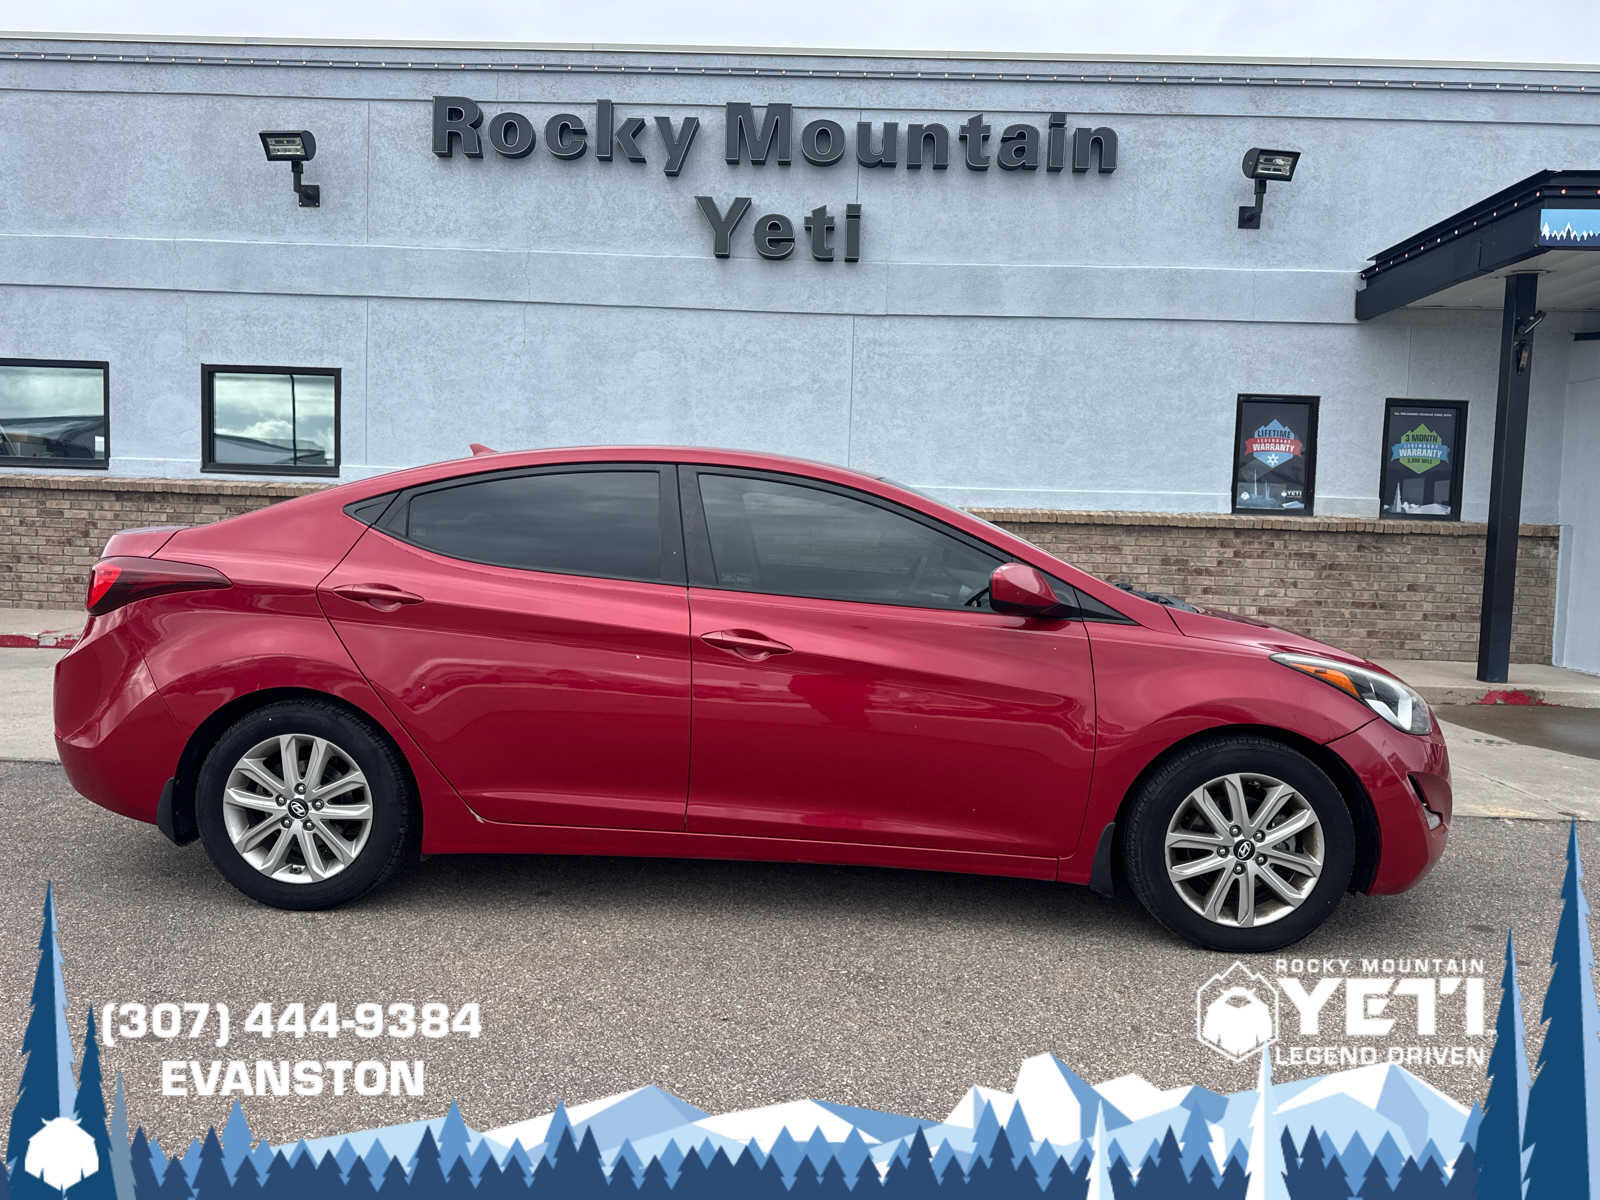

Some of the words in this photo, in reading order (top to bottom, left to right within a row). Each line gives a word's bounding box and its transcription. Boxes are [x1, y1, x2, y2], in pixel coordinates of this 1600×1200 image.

[432, 95, 700, 177] Rocky
[725, 102, 1118, 174] Mountain
[695, 195, 862, 262] Yeti
[1257, 429, 1291, 439] LIFETIME
[1252, 443, 1295, 453] WARRANTY
[1399, 448, 1442, 458] WARRANTY
